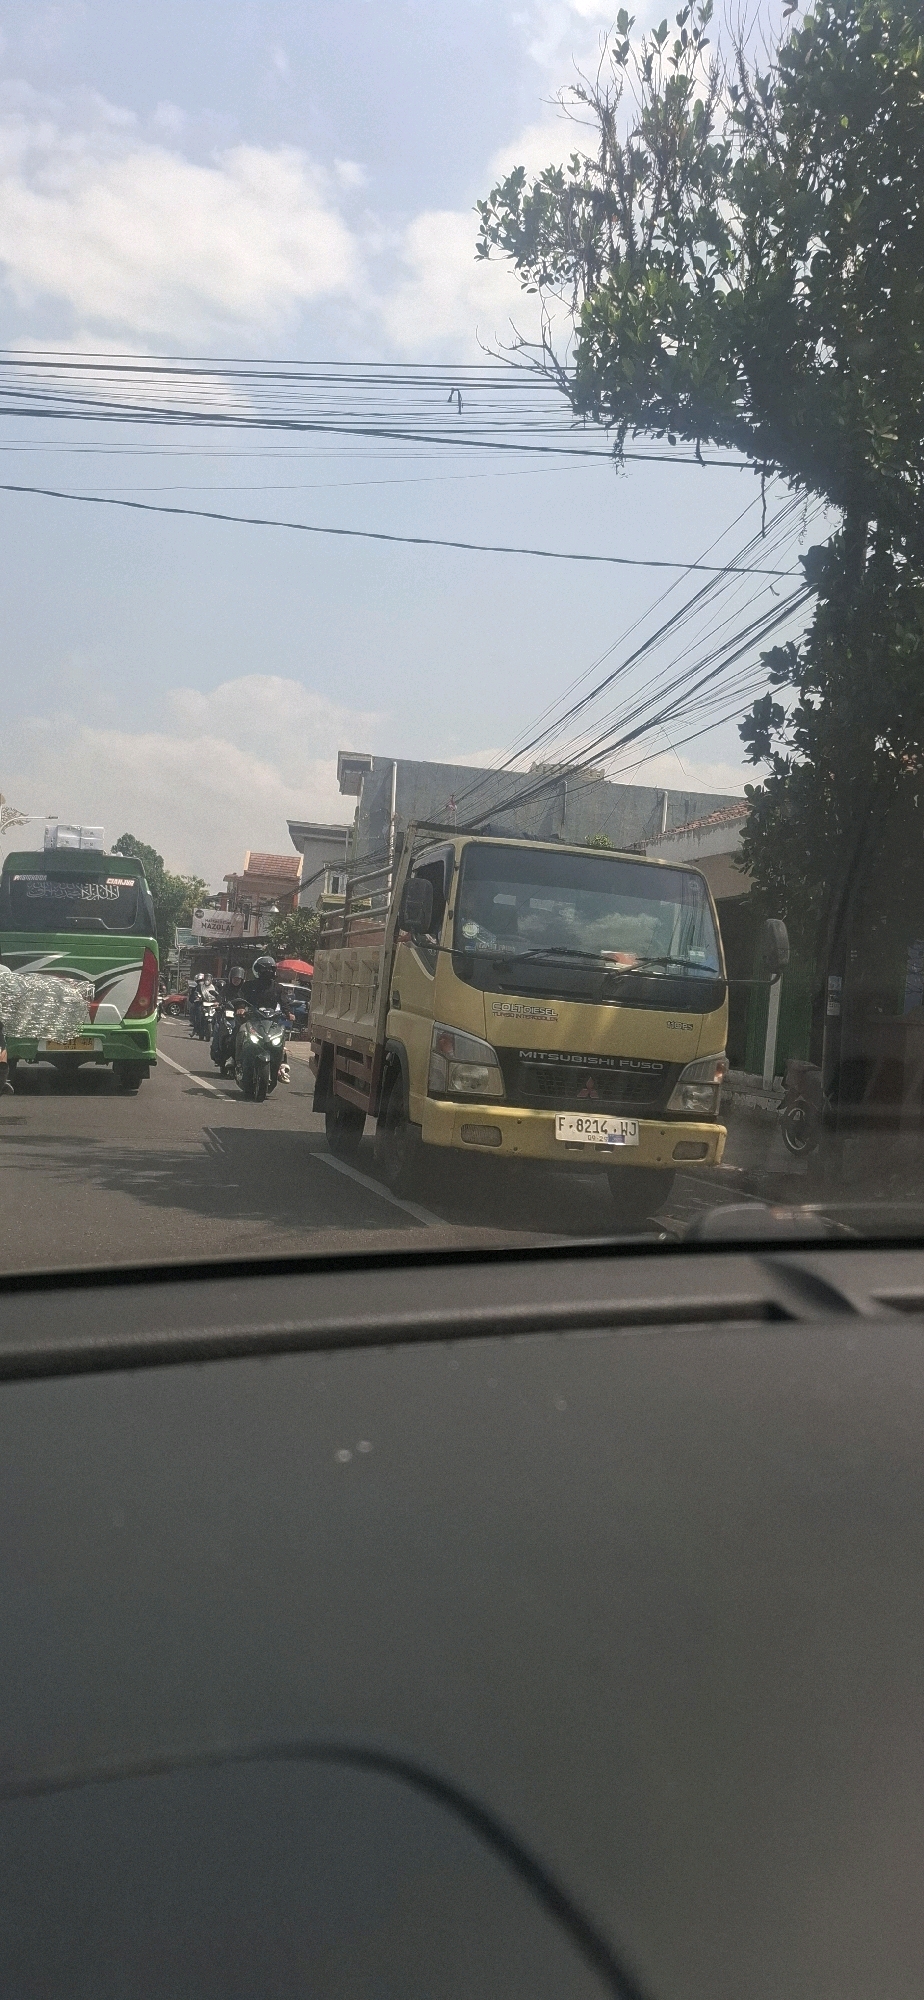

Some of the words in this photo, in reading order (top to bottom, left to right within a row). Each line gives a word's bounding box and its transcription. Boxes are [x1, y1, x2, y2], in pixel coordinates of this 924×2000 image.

[105, 877, 136, 887] CIANJUR
[492, 1002, 523, 1013] COLT
[523, 1006, 558, 1016] DIESEL
[515, 1013, 558, 1022] INTERCOOLER
[518, 1050, 615, 1066] MITSUBISHI
[619, 1059, 664, 1070] FUSO
[558, 1116, 566, 1132] F
[576, 1118, 608, 1134] 8214
